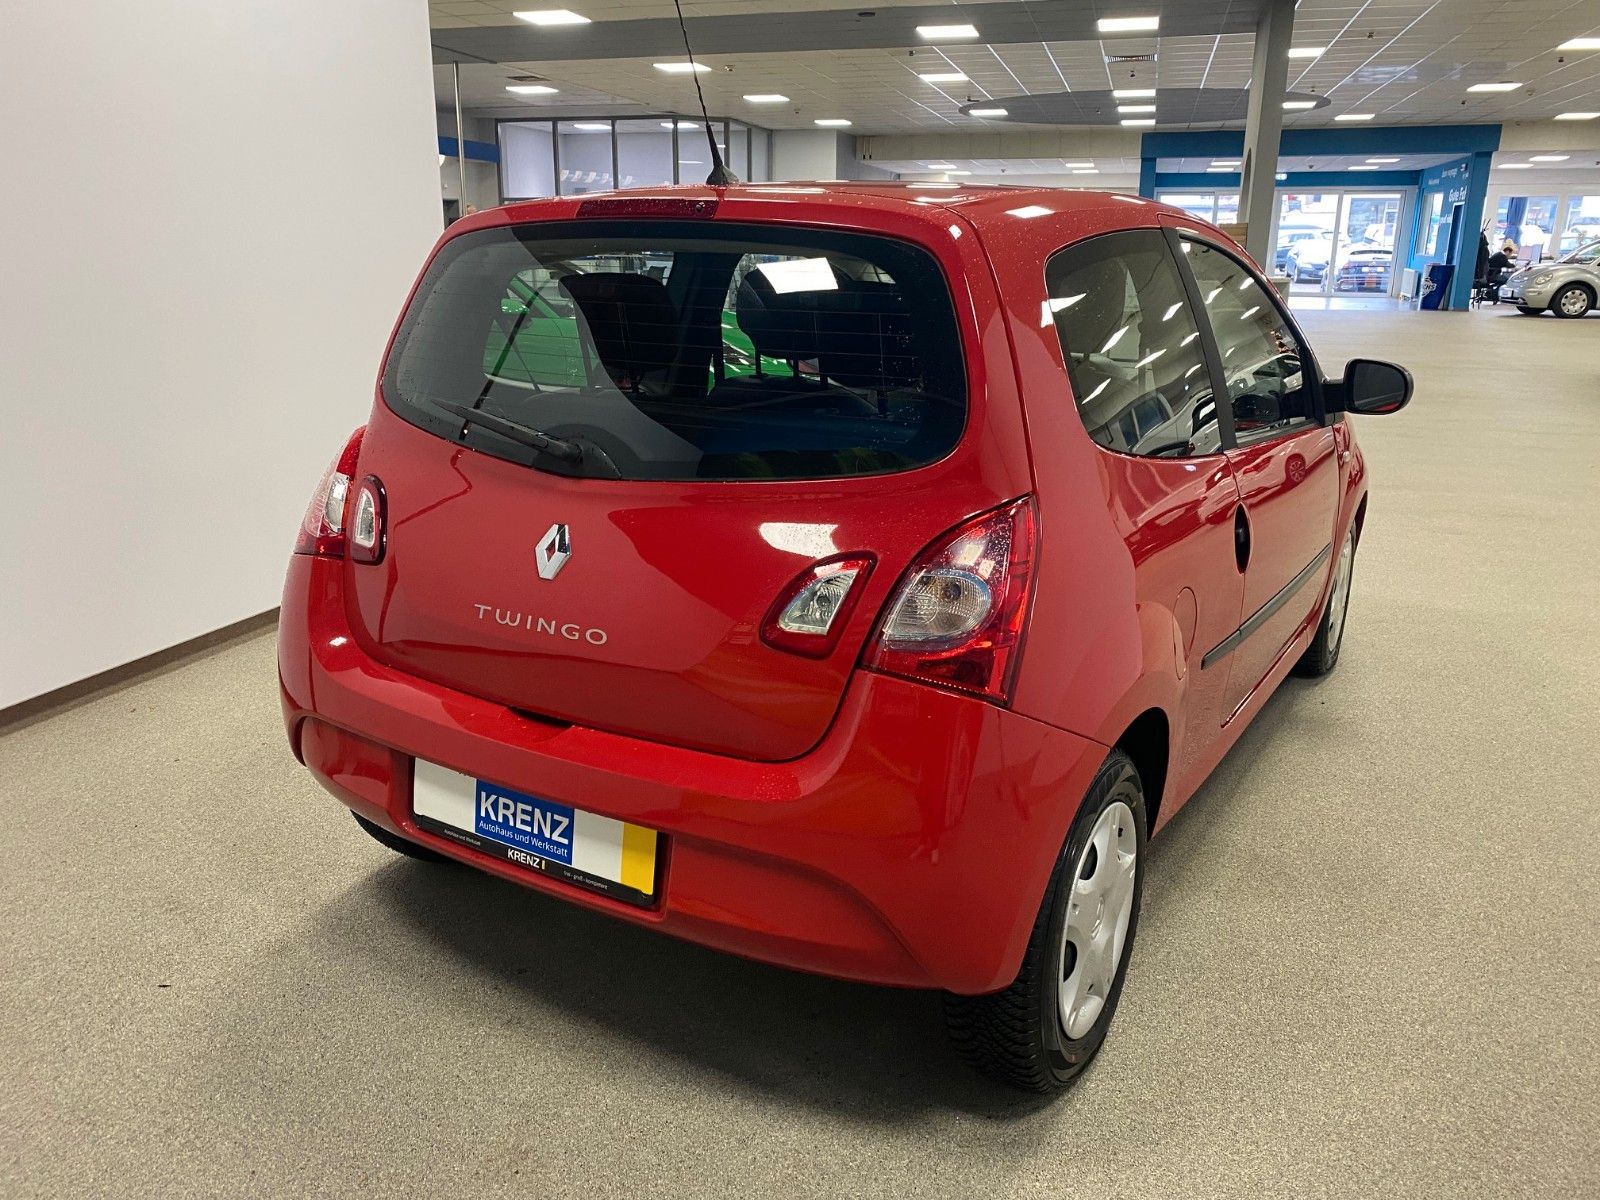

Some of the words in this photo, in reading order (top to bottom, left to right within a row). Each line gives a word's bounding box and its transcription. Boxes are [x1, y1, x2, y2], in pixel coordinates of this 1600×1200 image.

[474, 603, 608, 645] TWINGO
[480, 791, 570, 845] KRENZ
[479, 820, 513, 839] Autohaus
[514, 832, 530, 844] und
[530, 836, 568, 858] Werkstatt
[507, 848, 540, 869] KRENZ
